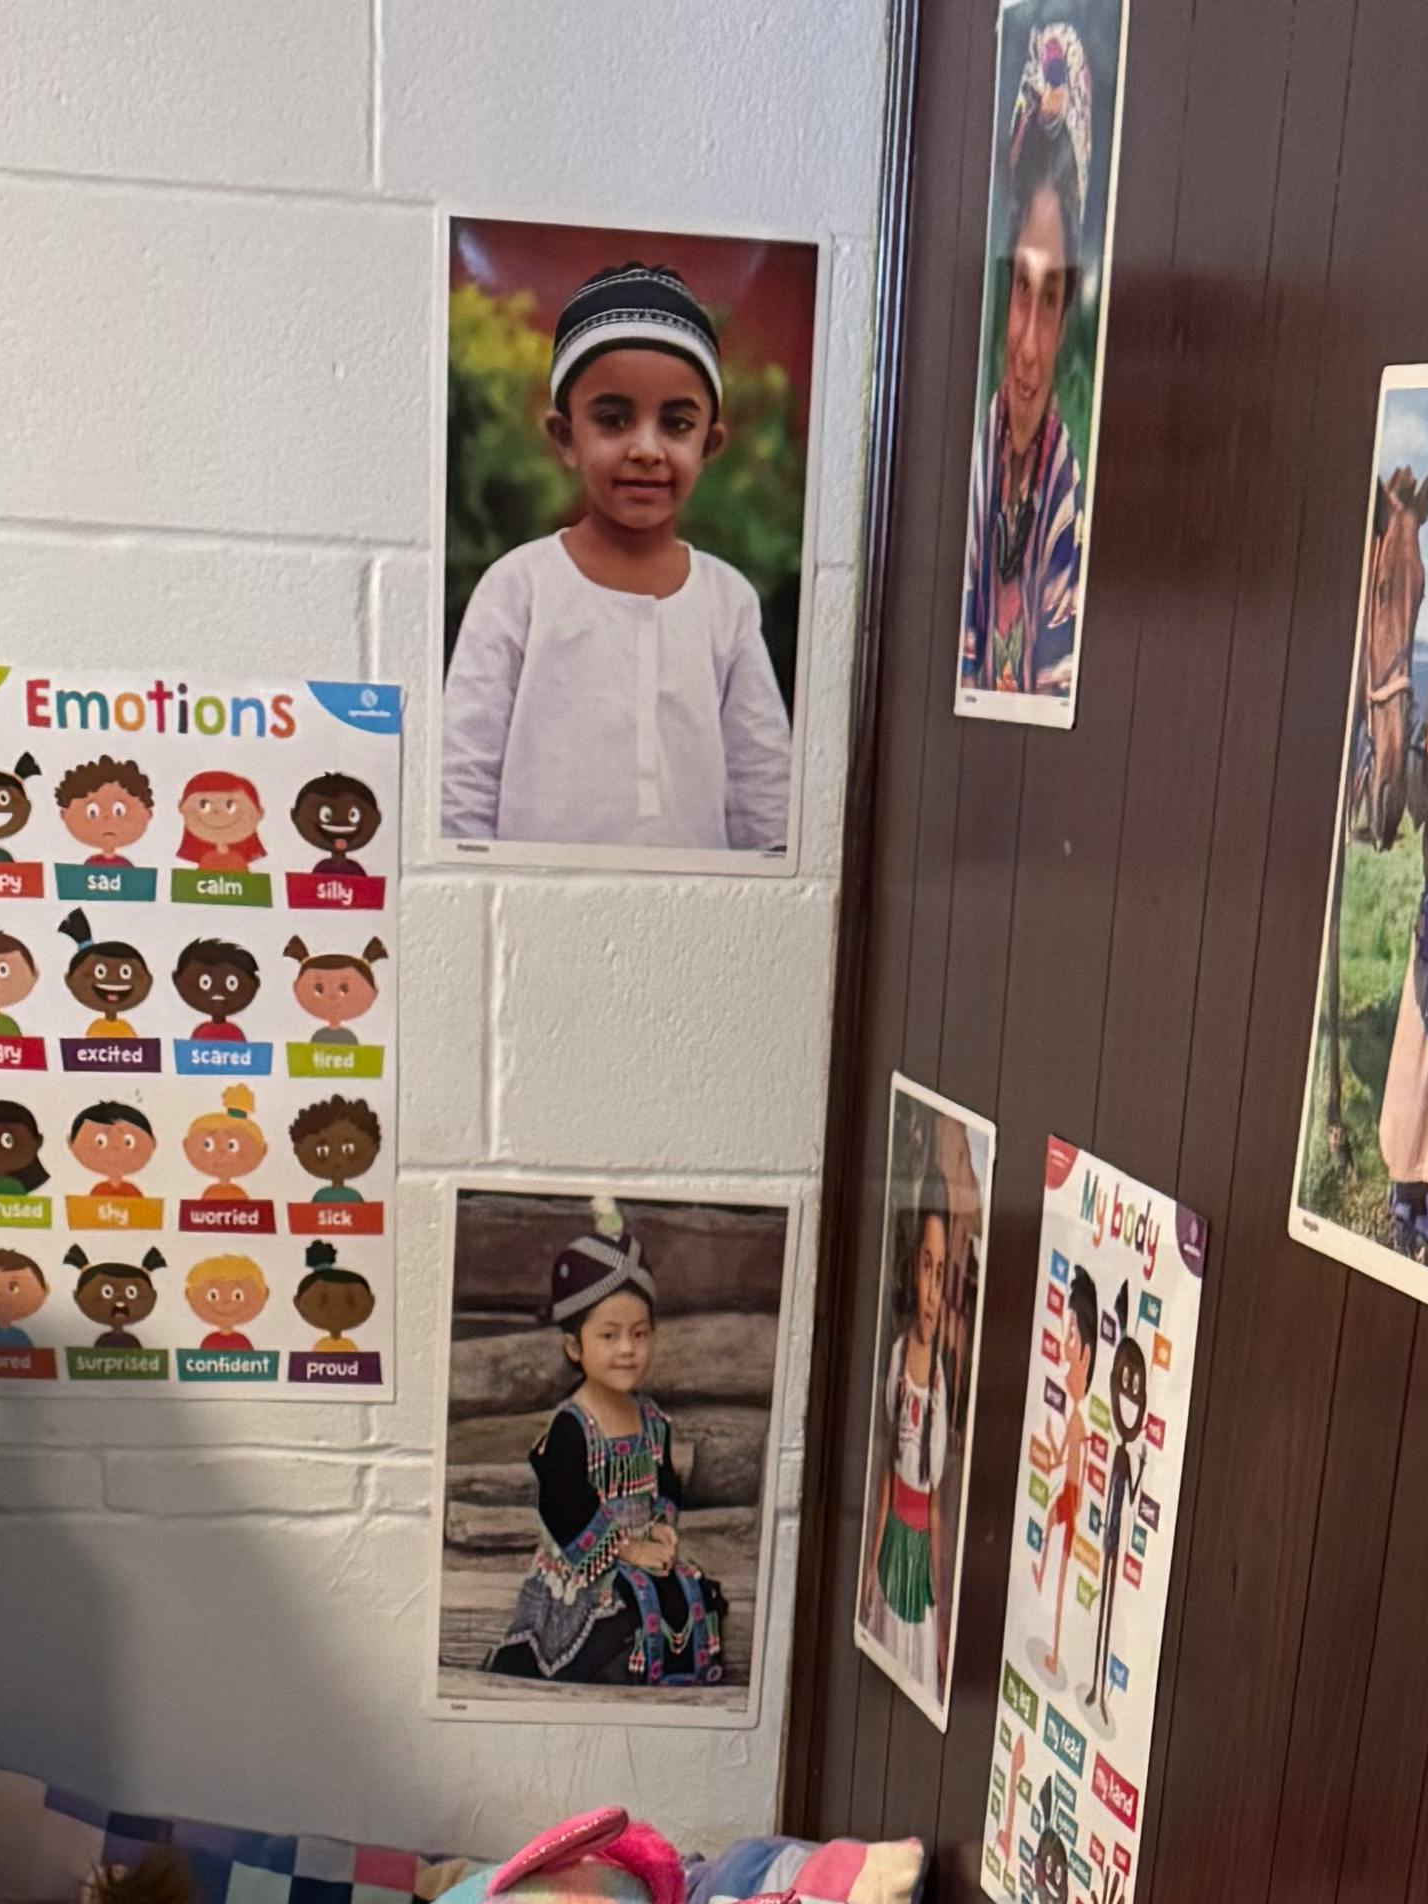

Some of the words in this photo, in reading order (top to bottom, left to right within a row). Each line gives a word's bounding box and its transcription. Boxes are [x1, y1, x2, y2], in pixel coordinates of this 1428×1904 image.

[26, 679, 296, 738] Emotions
[87, 873, 121, 891] sad
[196, 877, 243, 896] calm
[316, 880, 354, 904] silly
[77, 1045, 143, 1063] excited
[191, 1048, 252, 1066] scared
[313, 1051, 354, 1069] tired
[98, 1203, 128, 1226] shy
[190, 1208, 259, 1226] worried
[317, 1210, 353, 1227] sick
[1080, 1168, 1106, 1248] My
[1110, 1183, 1161, 1281] body
[76, 1354, 160, 1374] surprised
[185, 1356, 270, 1374] confident
[306, 1359, 359, 1379] proud
